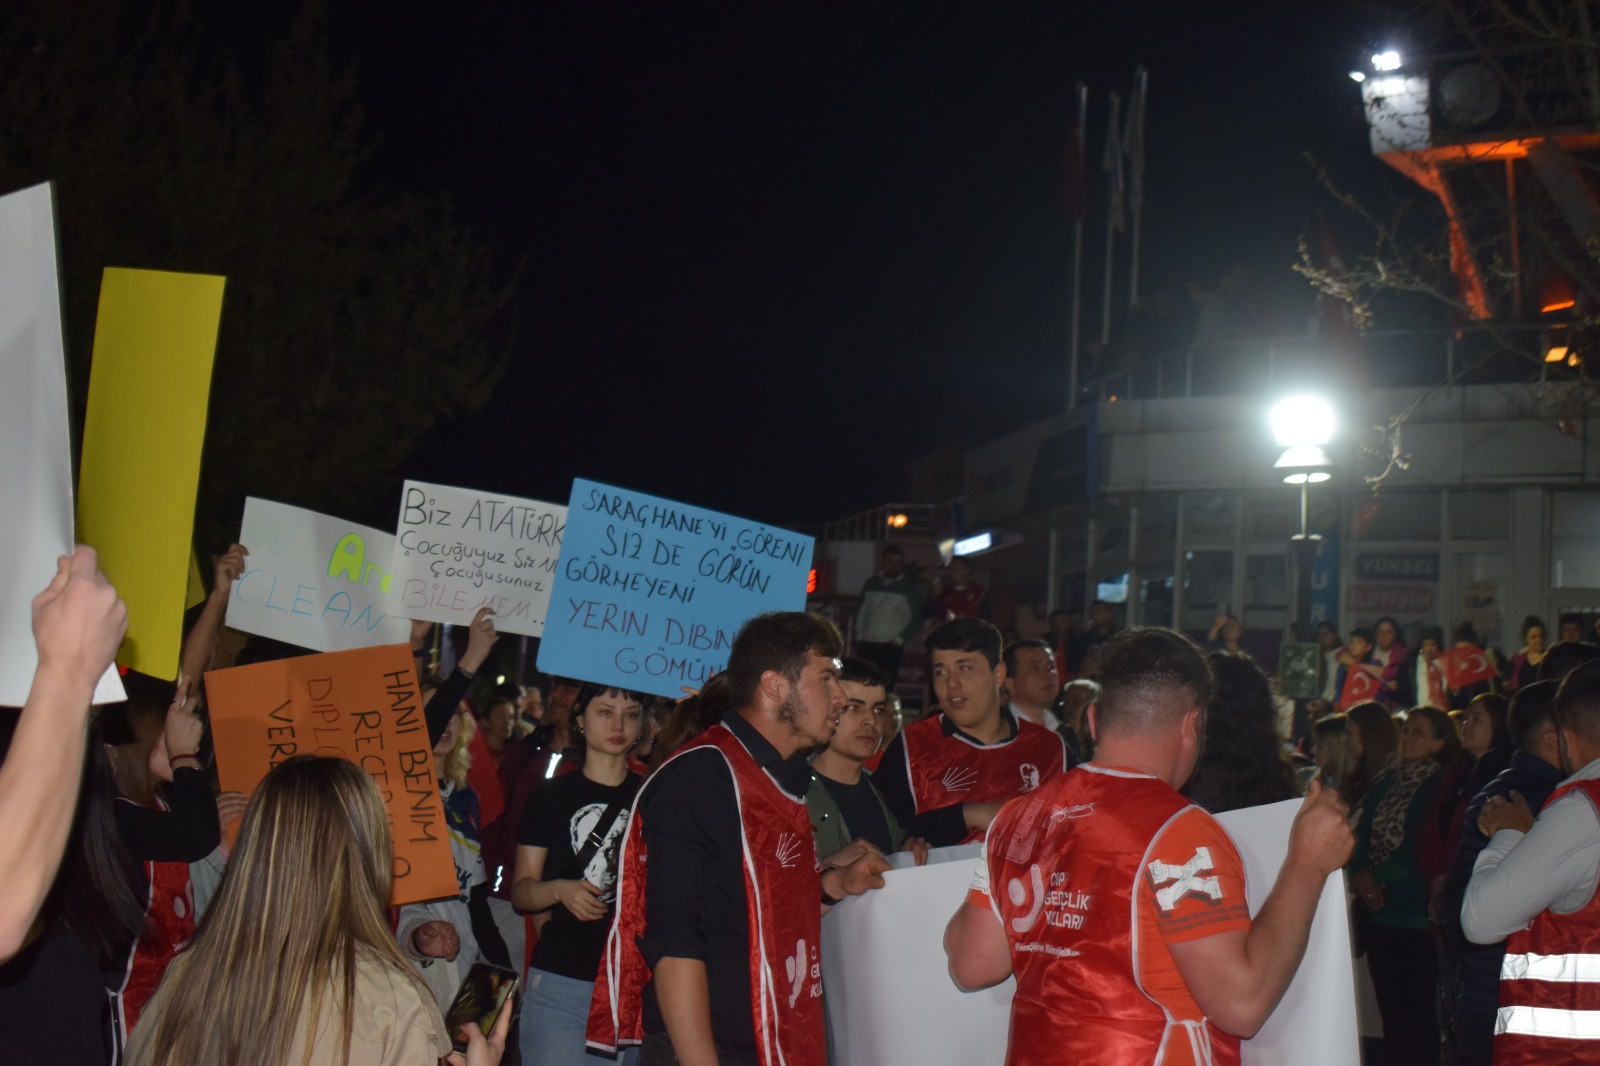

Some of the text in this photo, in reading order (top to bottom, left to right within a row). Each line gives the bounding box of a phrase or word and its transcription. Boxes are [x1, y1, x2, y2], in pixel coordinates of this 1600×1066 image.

[402, 487, 566, 547] Biz ATATÜRK
[430, 560, 545, 592] Çocuğusunuz
[565, 555, 696, 603] GÖRMEYENİ
[652, 538, 685, 566] DE
[698, 545, 770, 594] GÖRÜN
[1362, 557, 1435, 574] YÜKSEL
[236, 568, 386, 631] CLEAN
